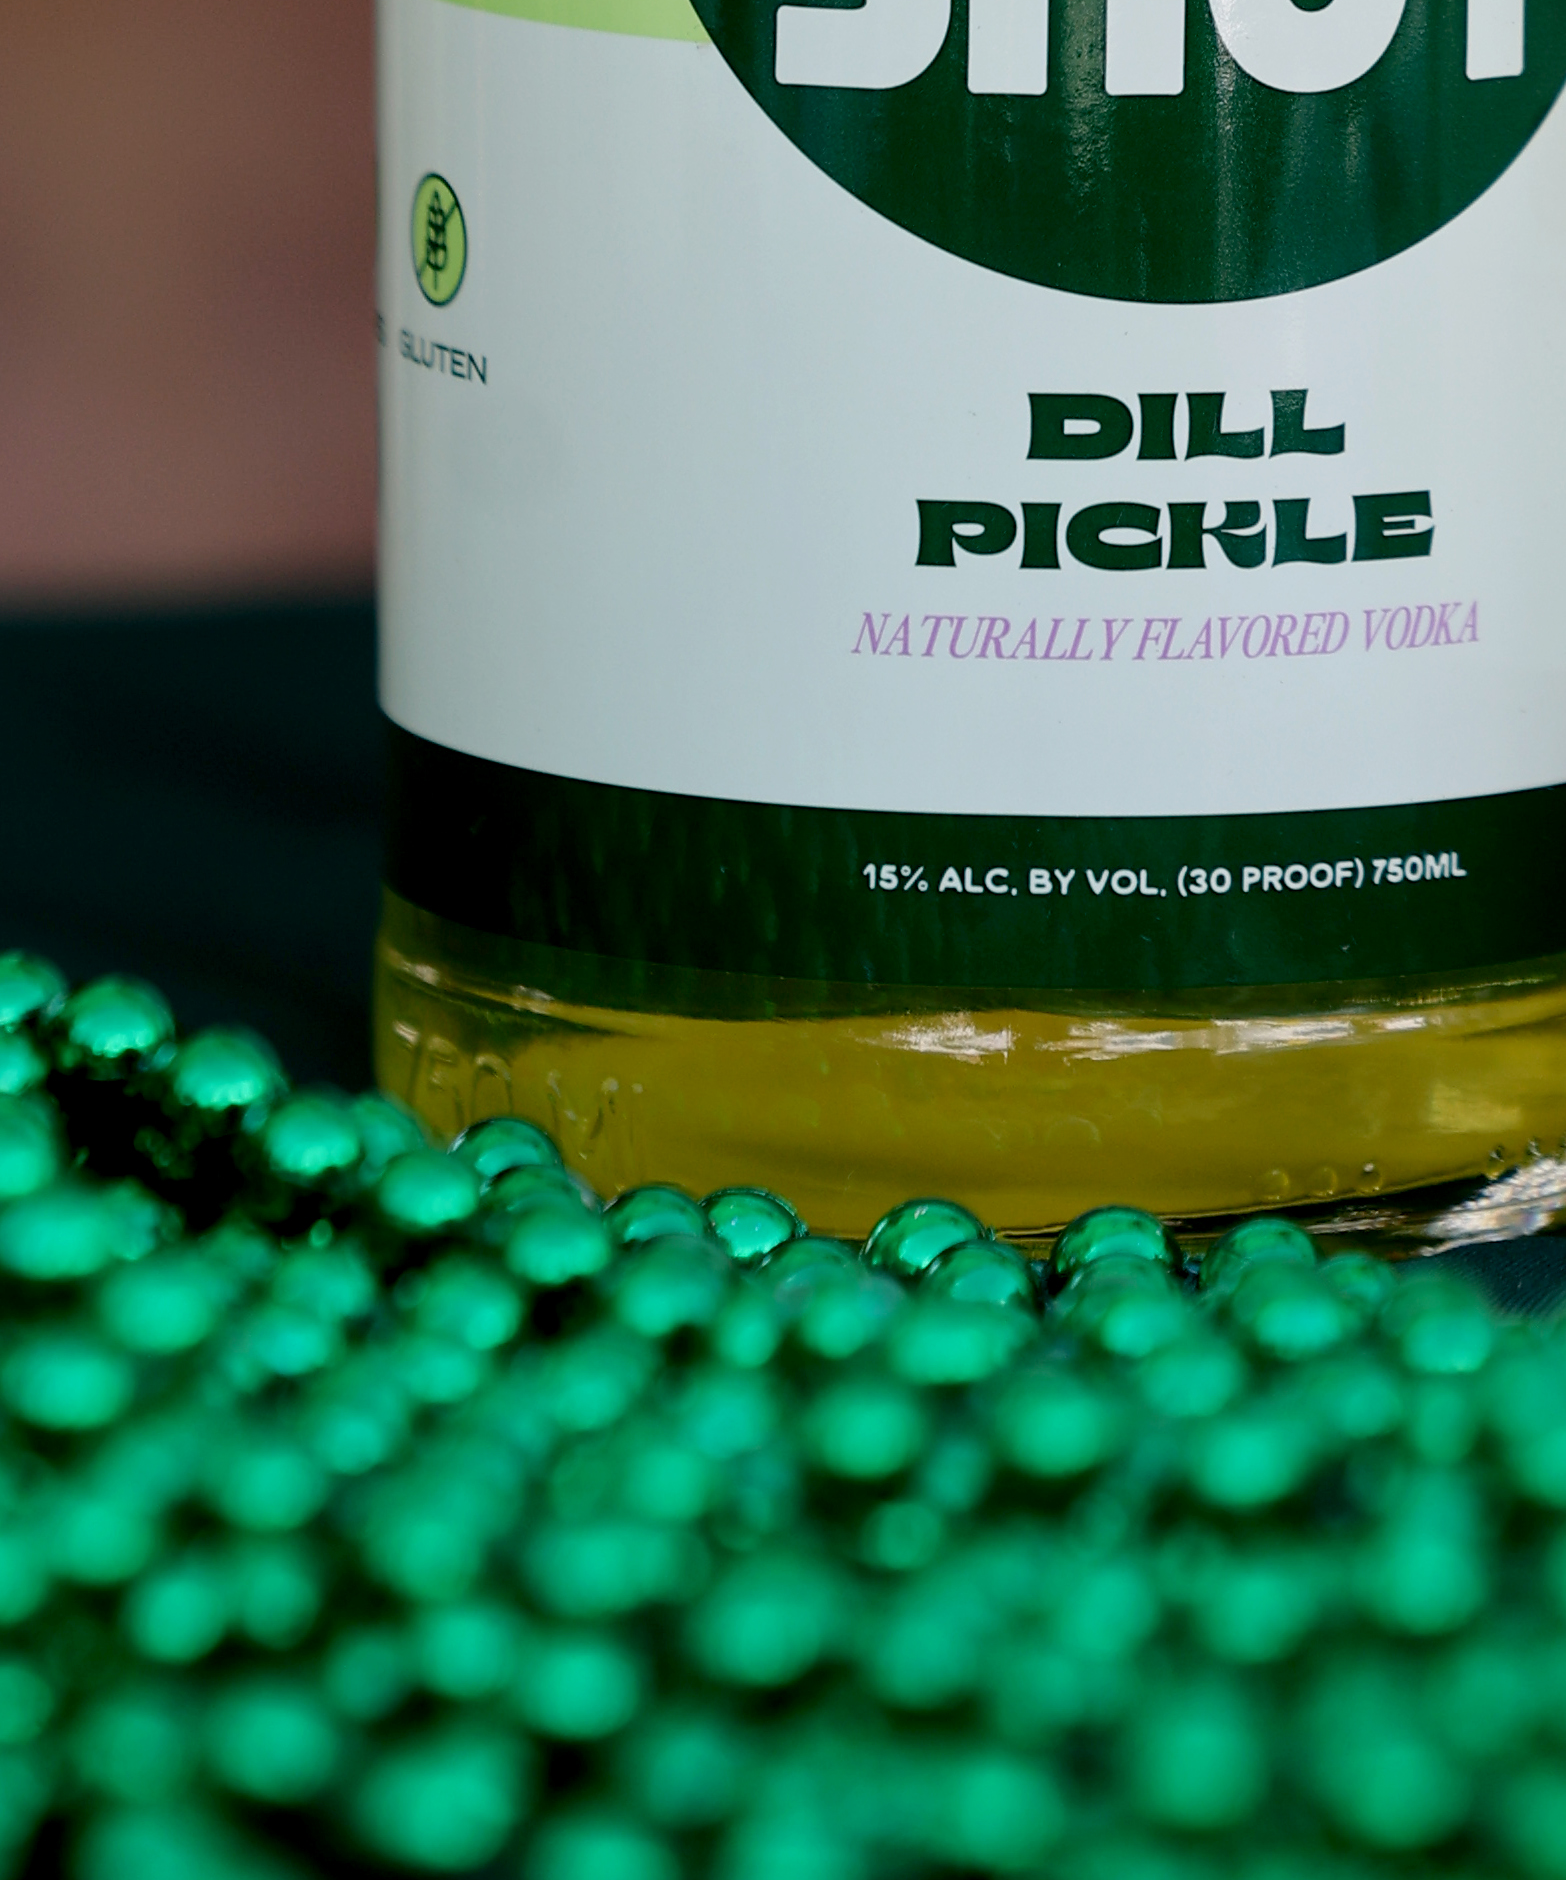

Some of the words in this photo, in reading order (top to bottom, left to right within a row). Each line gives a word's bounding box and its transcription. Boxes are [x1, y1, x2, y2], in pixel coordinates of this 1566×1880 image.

[400, 329, 487, 385] GLUTEN
[1026, 389, 1345, 461] DILL
[915, 490, 1435, 572] PICKLE
[851, 612, 1134, 661] NATURALLY
[1132, 609, 1350, 662] FLAVORED
[1363, 600, 1481, 652] VODKA
[863, 862, 929, 892] 15%
[1029, 868, 1076, 895] BY
[1086, 868, 1167, 898] VOL.
[1177, 865, 1232, 898] (30
[1242, 860, 1364, 893] PROOF)
[1371, 851, 1467, 884] 750ML
